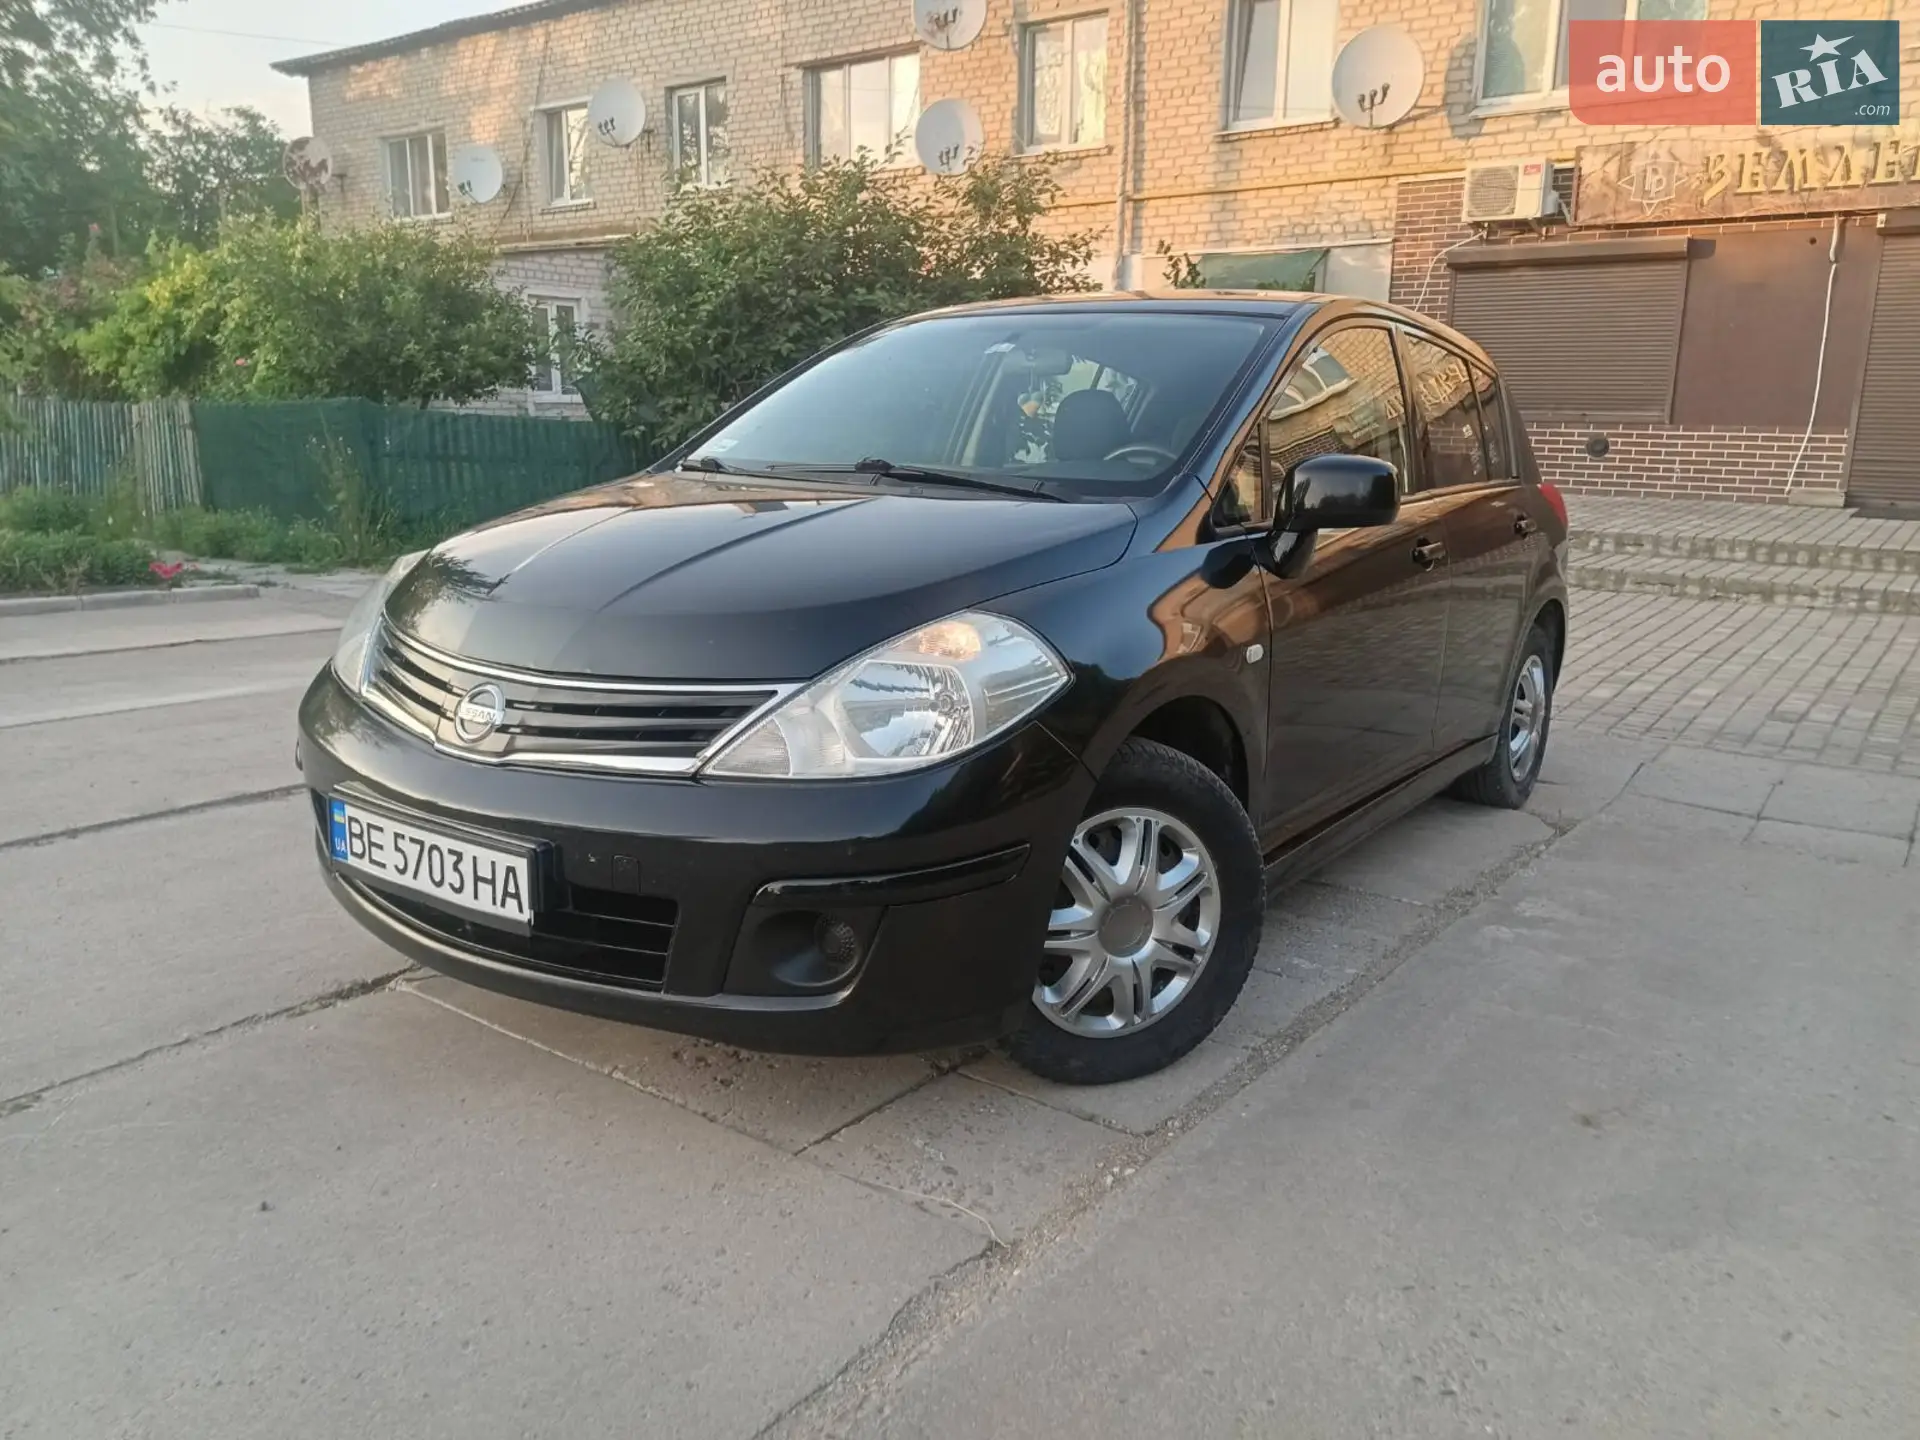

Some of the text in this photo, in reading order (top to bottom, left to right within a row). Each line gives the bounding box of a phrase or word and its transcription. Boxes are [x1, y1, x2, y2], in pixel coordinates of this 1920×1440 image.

[334, 837, 347, 853] UA
[347, 815, 524, 914] BE 5703 HA
